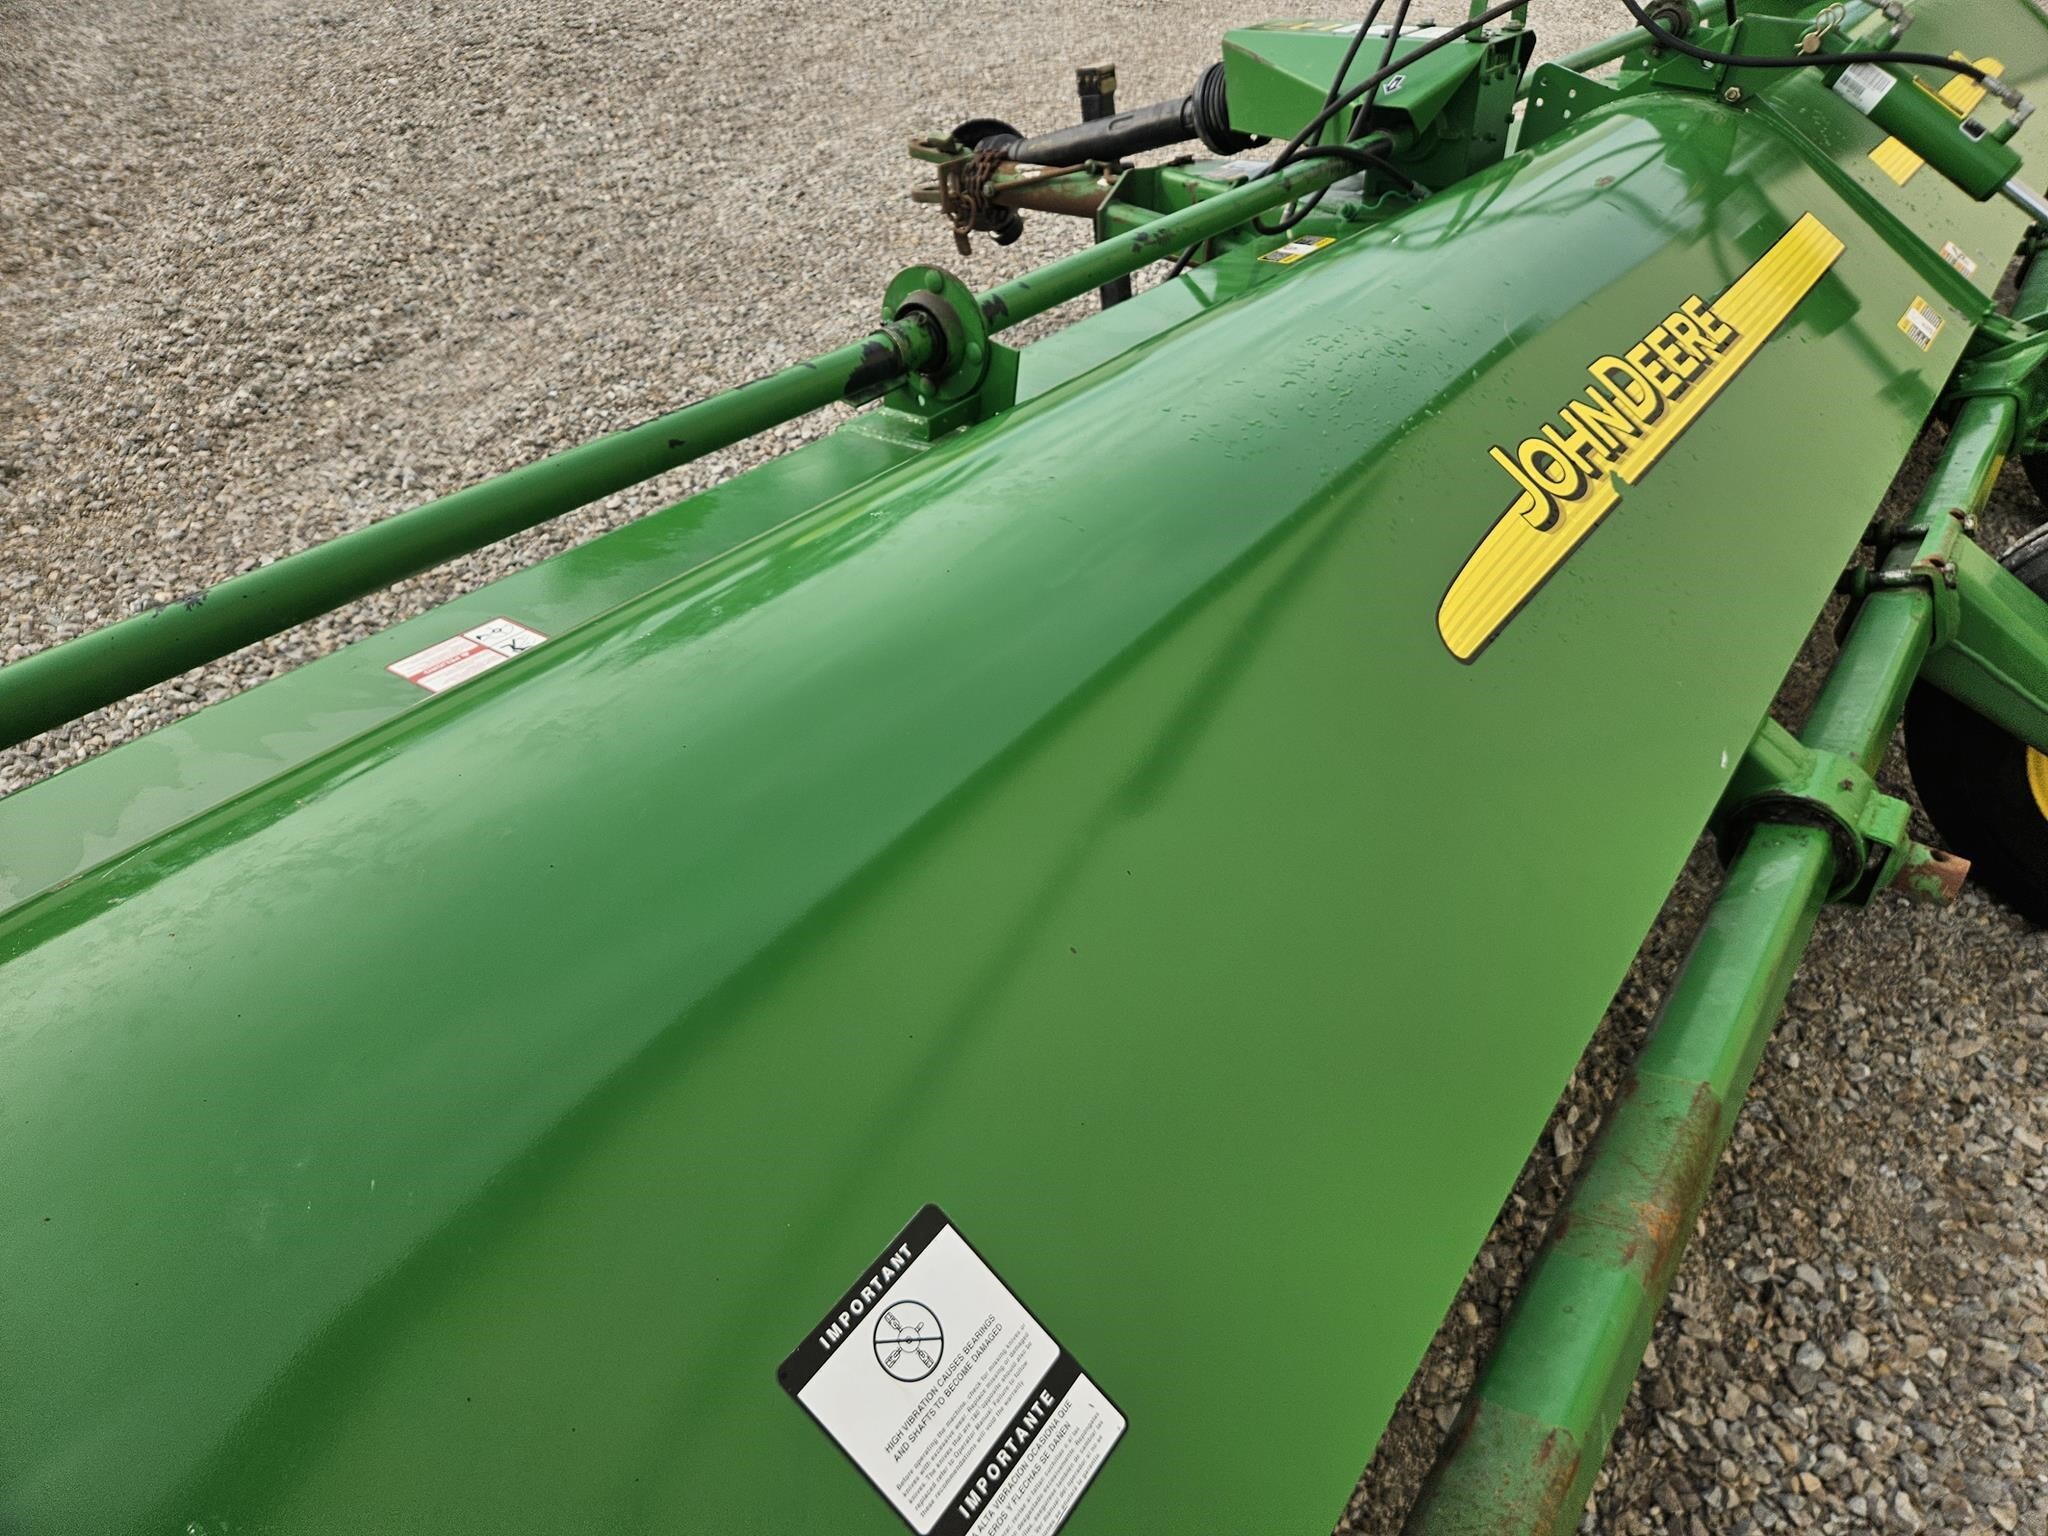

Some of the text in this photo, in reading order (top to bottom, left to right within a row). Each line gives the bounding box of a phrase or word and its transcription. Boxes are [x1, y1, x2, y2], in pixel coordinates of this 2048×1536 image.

[1487, 293, 1745, 532] JOHN DEERE
[820, 1243, 911, 1348] IMPORTANT
[884, 1313, 996, 1454] HIGH VIBRATION CAUSES BEARINGS
[893, 1322, 1003, 1463] AND SHAFTS TO BECOME DAMAGED
[959, 1390, 1053, 1518] IMPORTANTE
[977, 1509, 996, 1534] ALTA
[992, 1460, 1029, 1509] VIBRACION
[1026, 1418, 1060, 1462] OCASIONA
[1057, 1398, 1073, 1419] QUE
[1010, 1462, 1042, 1505] FLECHAS
[1039, 1449, 1051, 1465] SE
